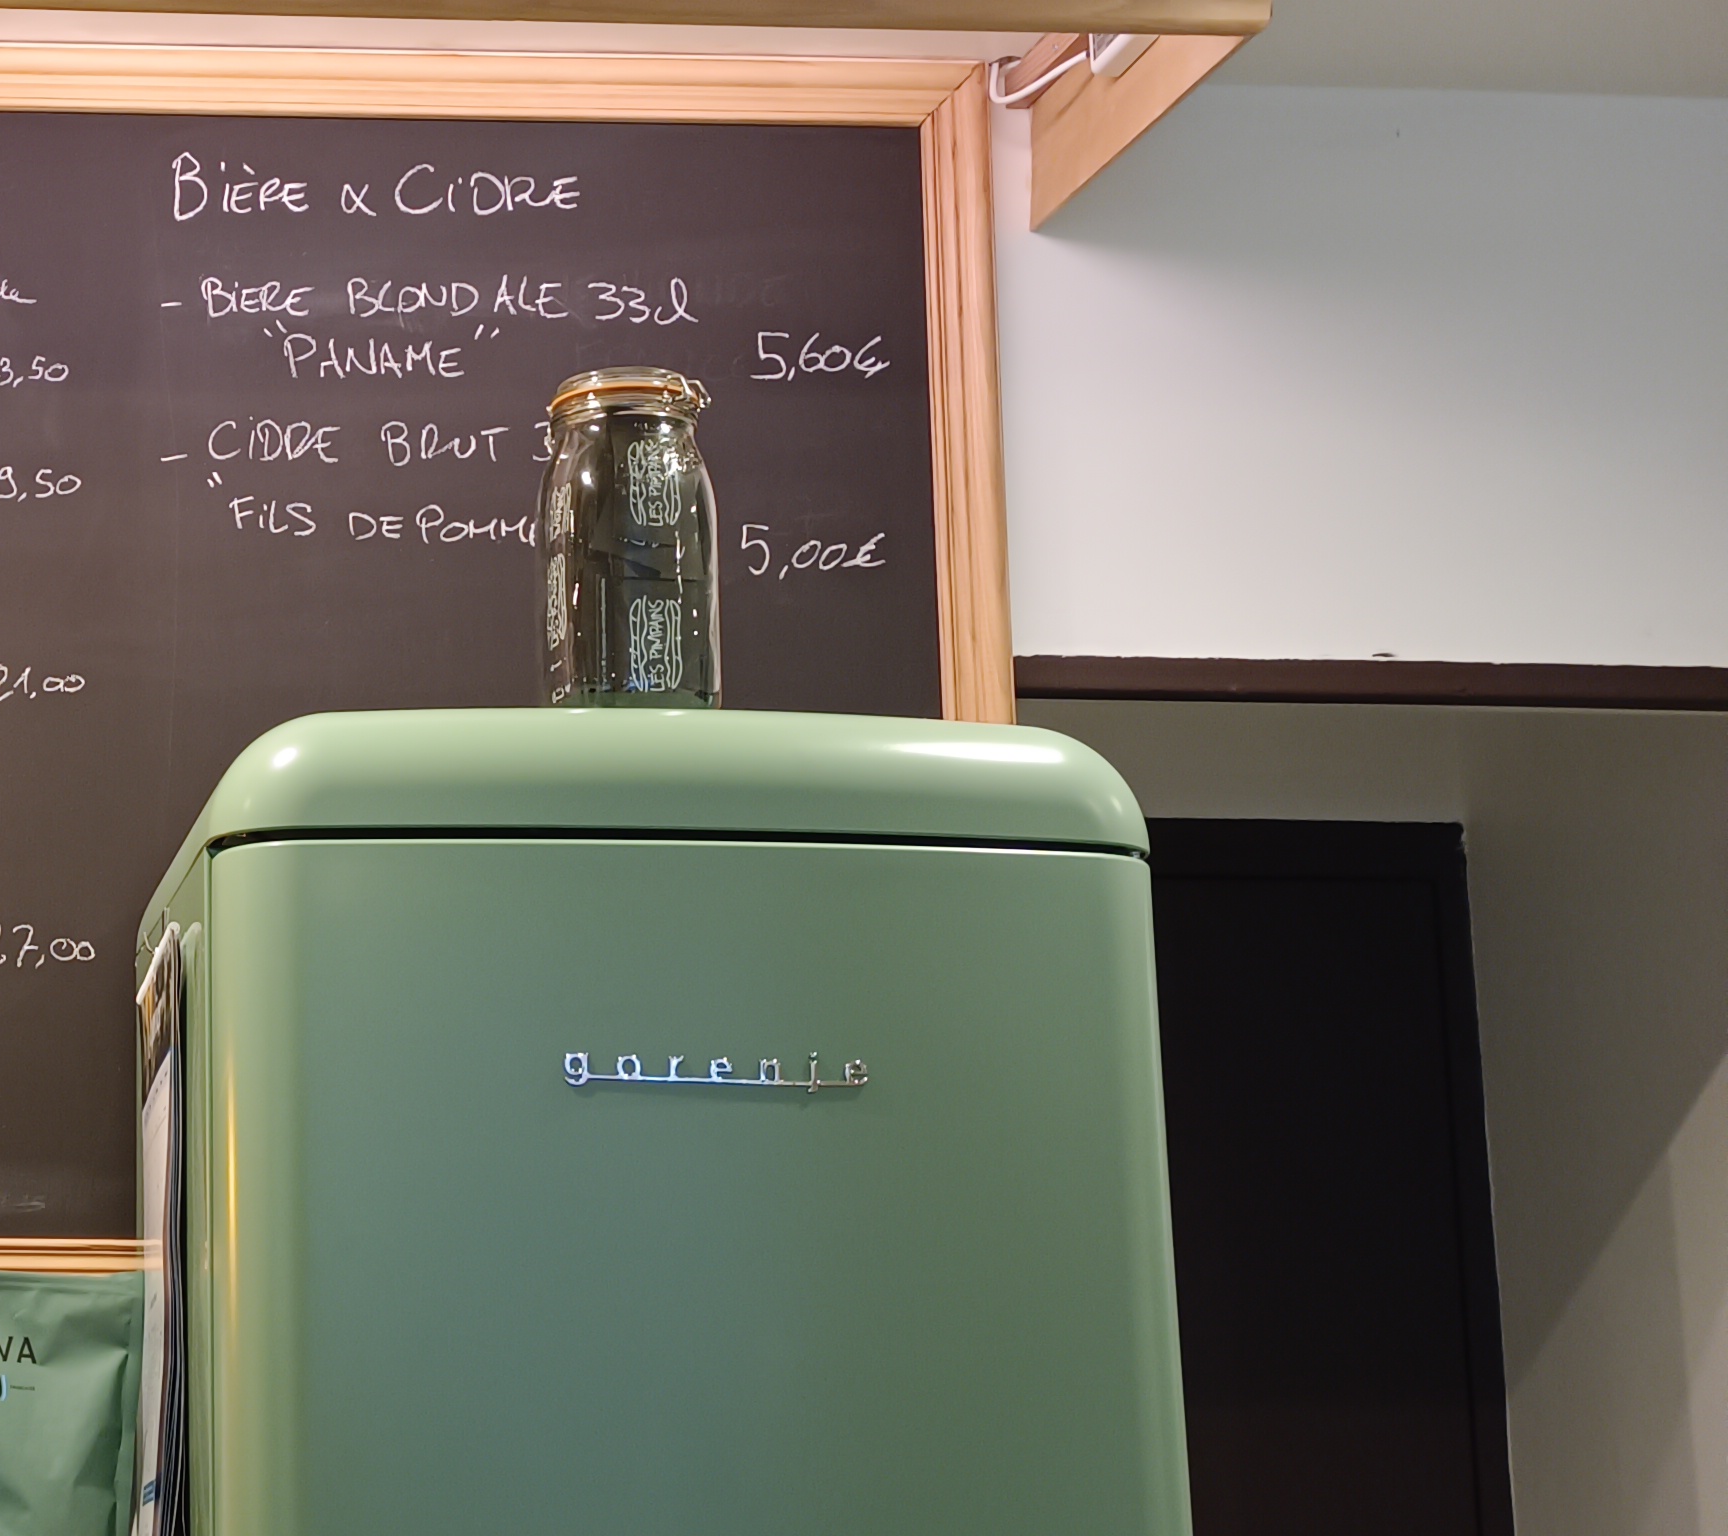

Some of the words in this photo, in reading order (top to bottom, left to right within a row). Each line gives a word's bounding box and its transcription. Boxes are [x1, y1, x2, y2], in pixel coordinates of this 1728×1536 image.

[749, 331, 891, 382] 5,60€
[380, 420, 509, 467] BRUT
[348, 511, 404, 541] DE
[740, 523, 886, 581] 5,00€
[564, 1051, 868, 1093] gorenje
